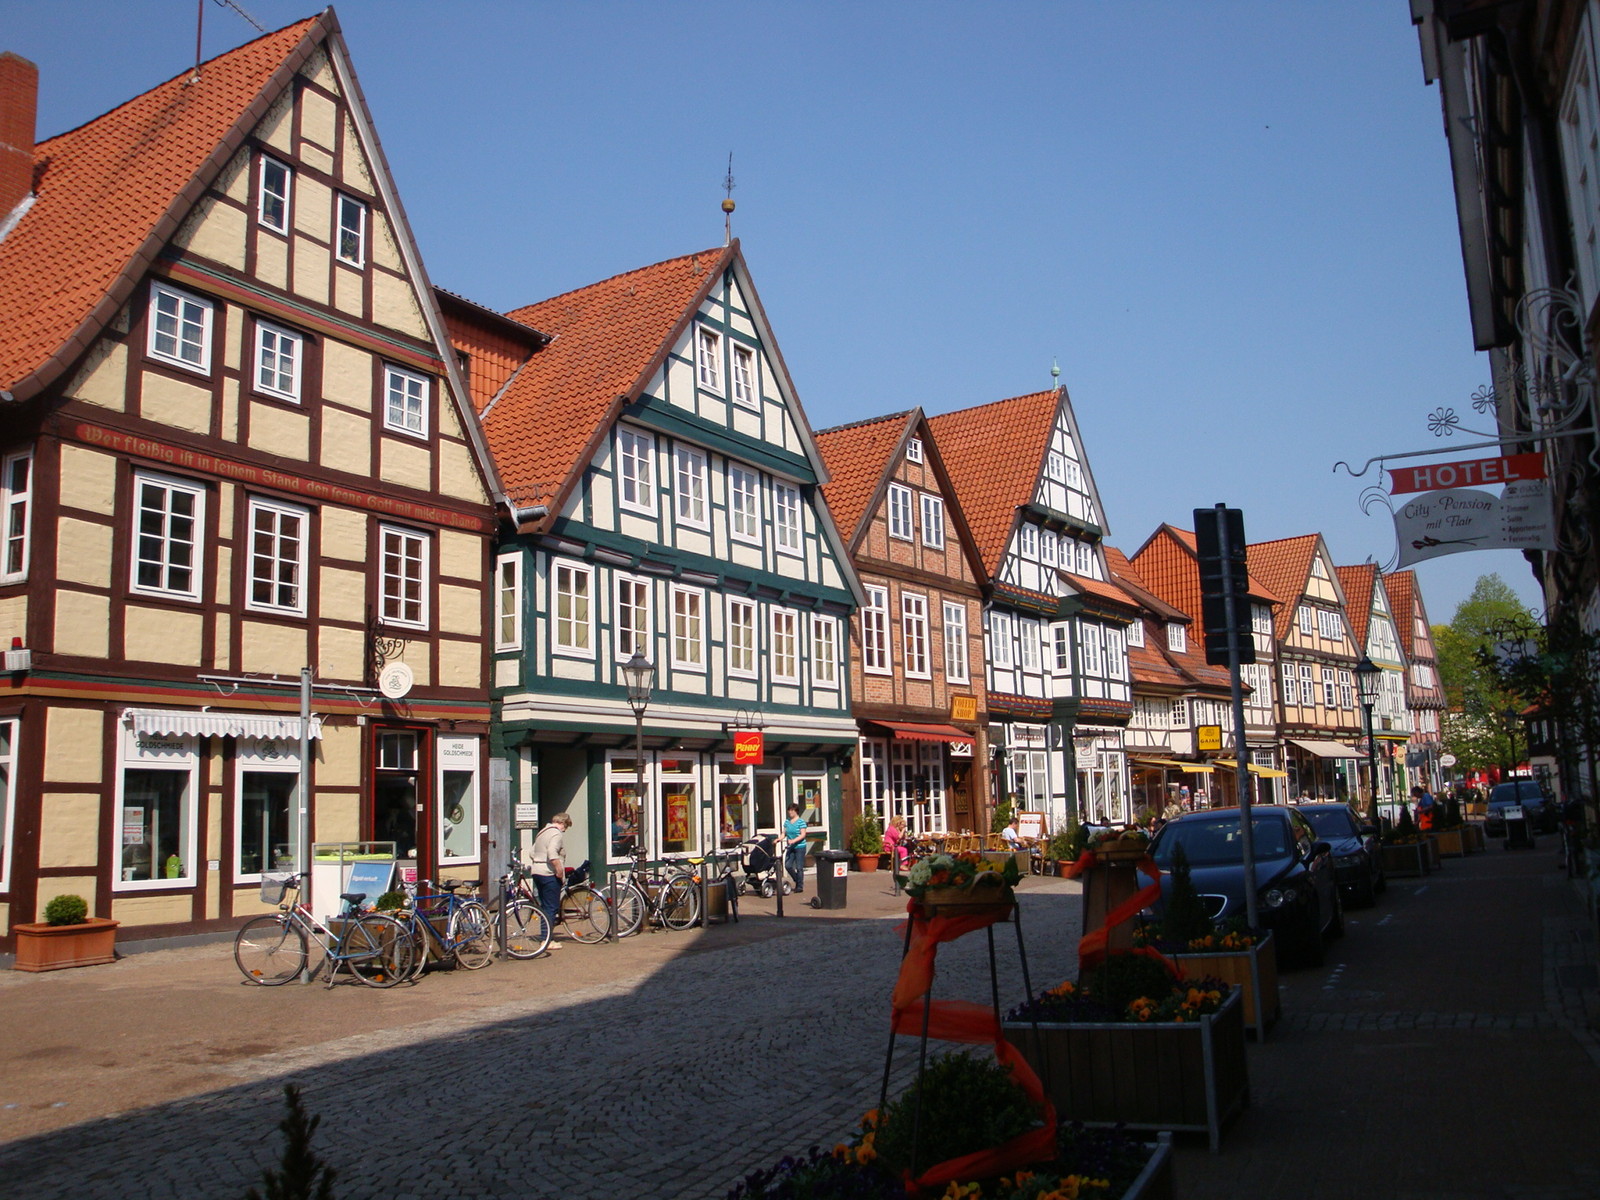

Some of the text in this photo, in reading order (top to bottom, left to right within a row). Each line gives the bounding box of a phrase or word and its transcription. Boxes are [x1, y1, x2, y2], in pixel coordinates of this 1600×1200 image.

[85, 426, 121, 447] Wer
[198, 454, 210, 469] in
[262, 470, 299, 490] Stand
[307, 481, 329, 496] den
[367, 496, 392, 510] Gott
[1413, 459, 1520, 489] HOTEL
[1404, 503, 1430, 519] City
[1439, 496, 1492, 511] Pension
[1426, 514, 1473, 530] mit Flair
[955, 698, 976, 709] COFFEE
[136, 740, 184, 751] GOLDSCHMIEDE
[735, 743, 761, 752] PENNY
